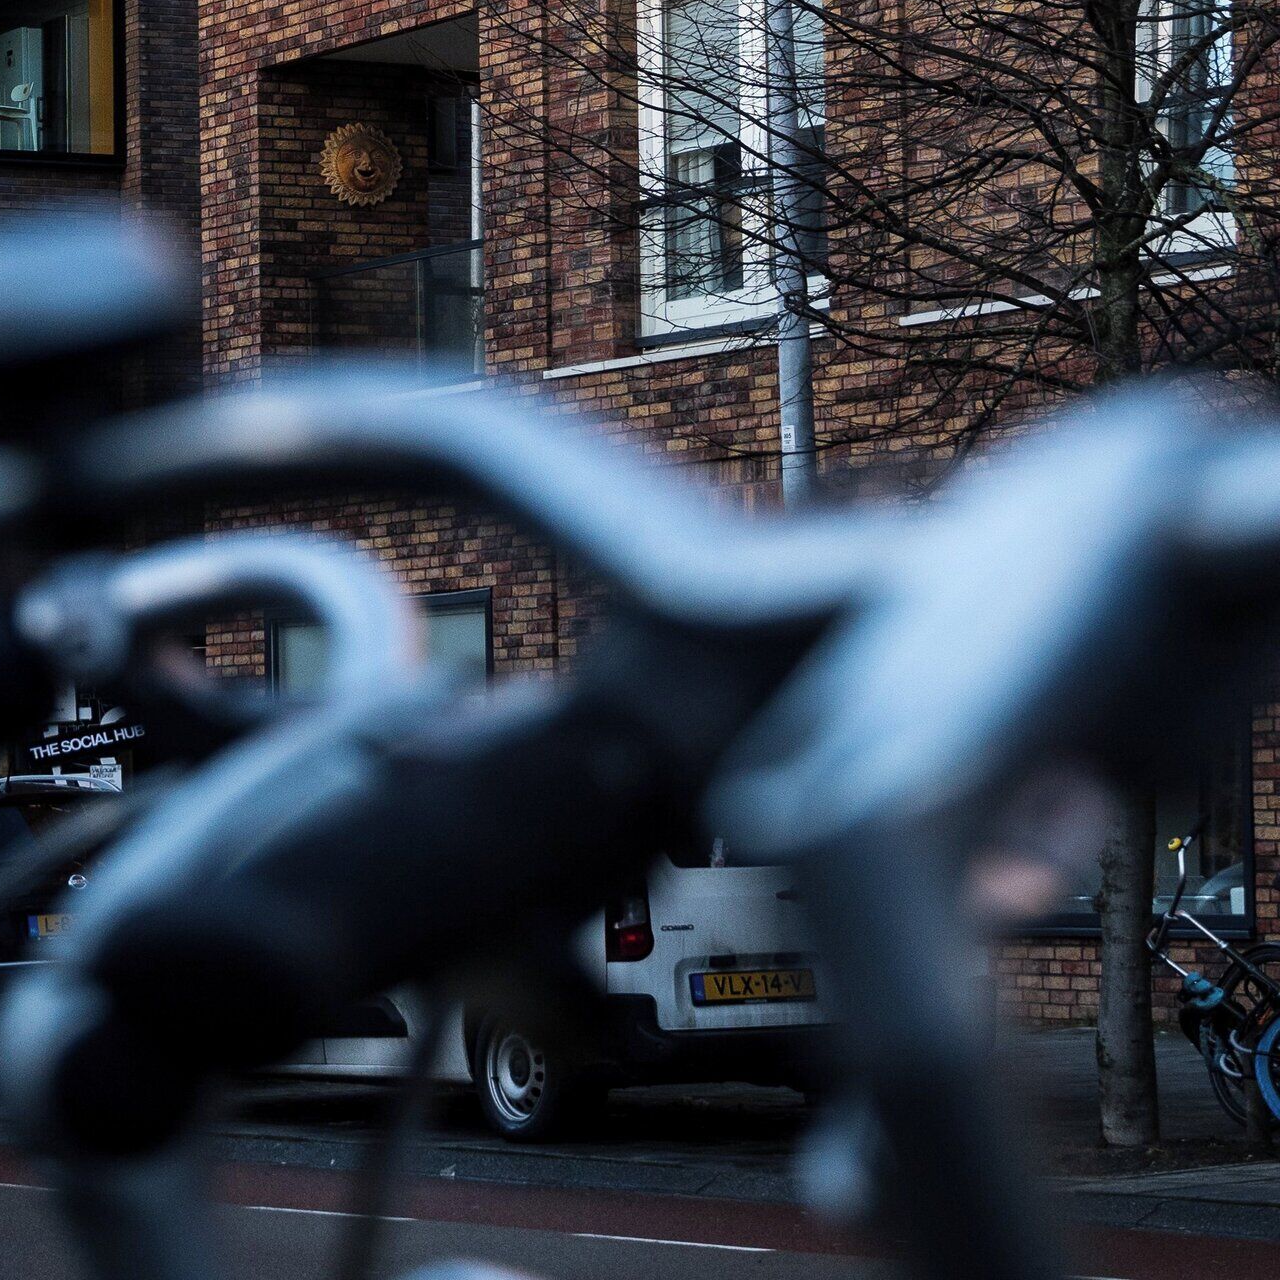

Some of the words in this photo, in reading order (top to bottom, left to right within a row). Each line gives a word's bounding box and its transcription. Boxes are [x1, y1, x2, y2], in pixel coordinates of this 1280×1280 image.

[30, 742, 60, 760] THE
[60, 731, 114, 753] SOCIAL
[113, 724, 146, 742] HUB
[713, 974, 802, 996] VLX-14-V
